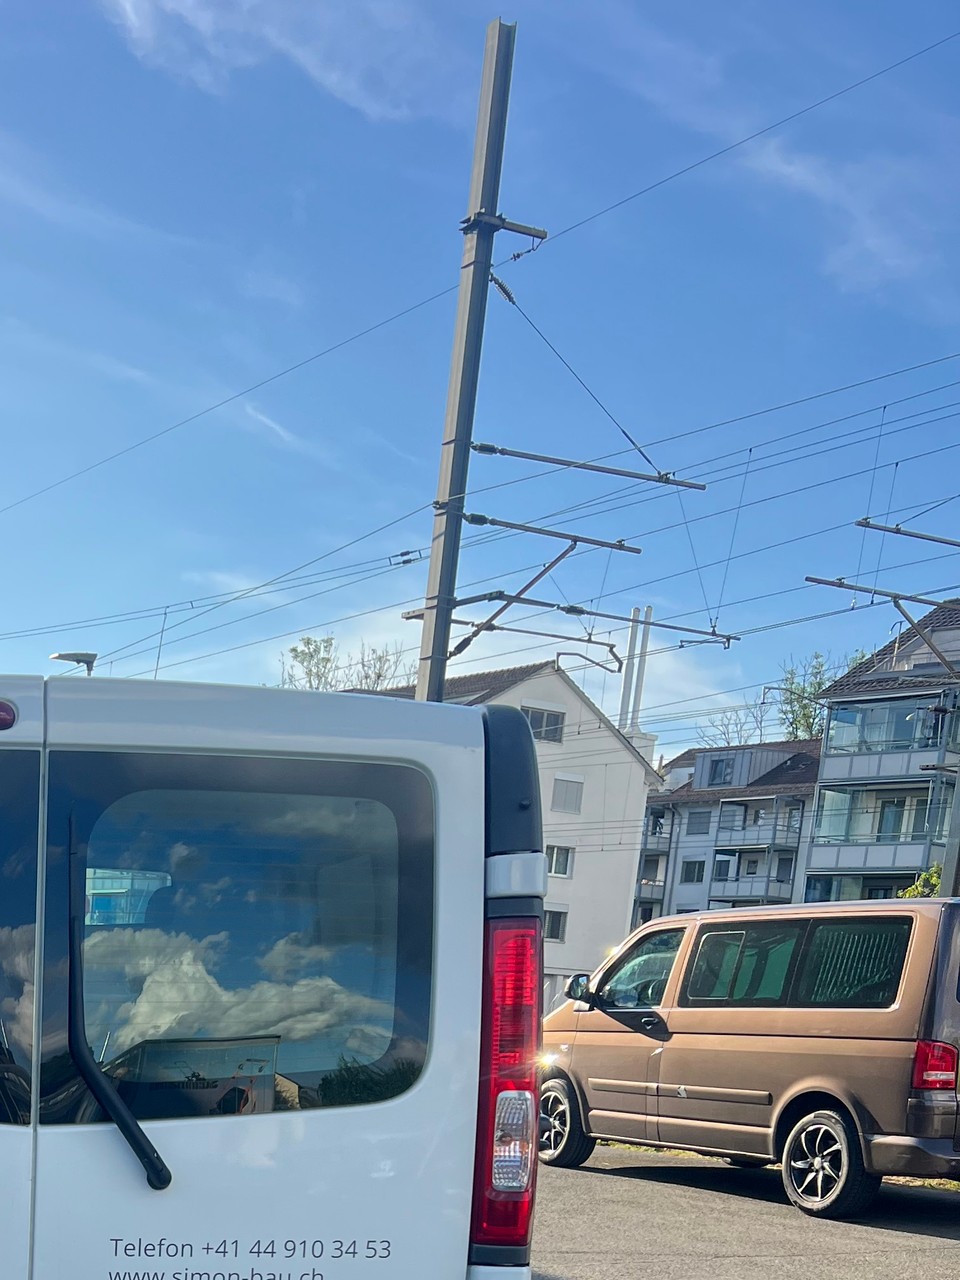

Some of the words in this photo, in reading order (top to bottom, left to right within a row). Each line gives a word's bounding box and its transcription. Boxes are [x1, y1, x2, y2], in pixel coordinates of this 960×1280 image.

[109, 1238, 194, 1258] Telefon
[201, 1239, 240, 1258] +41
[249, 1239, 277, 1259] 44
[284, 1239, 324, 1259] 910
[330, 1239, 359, 1259] 34
[365, 1240, 392, 1259] 53
